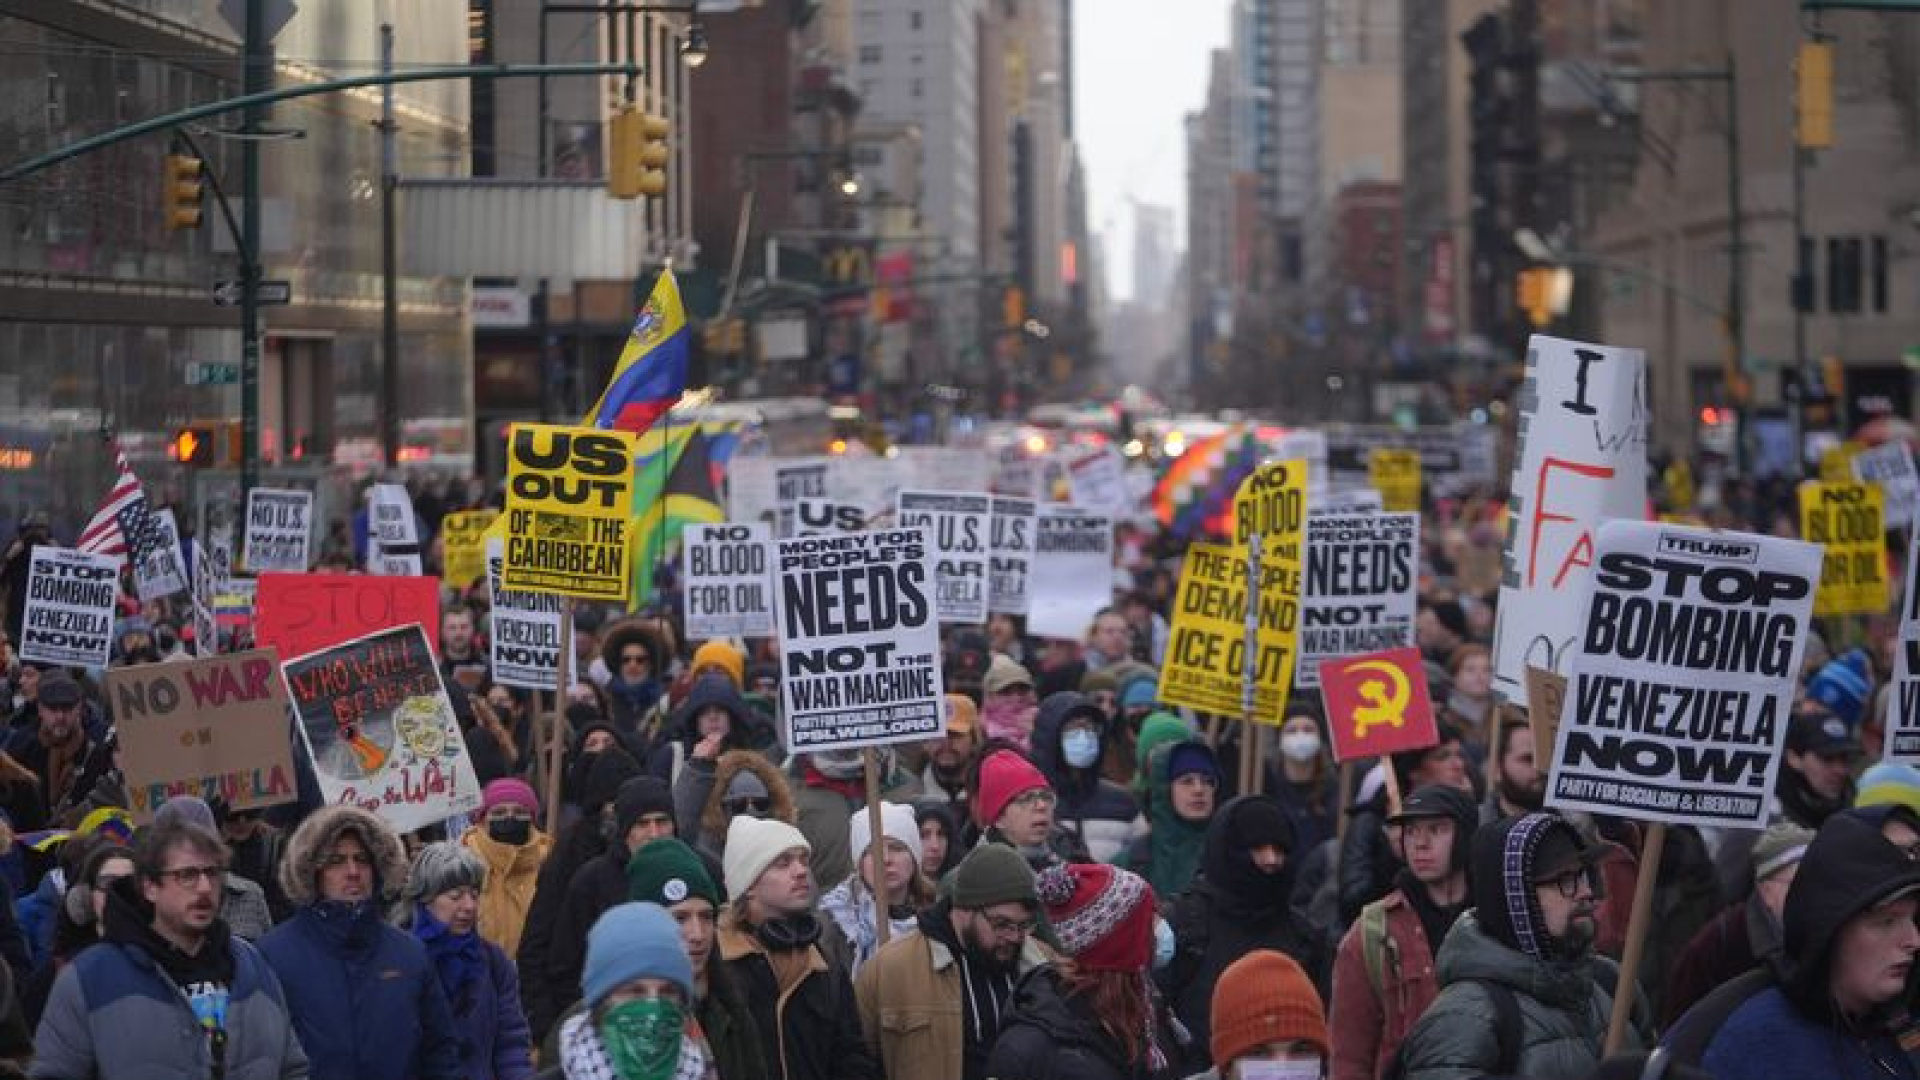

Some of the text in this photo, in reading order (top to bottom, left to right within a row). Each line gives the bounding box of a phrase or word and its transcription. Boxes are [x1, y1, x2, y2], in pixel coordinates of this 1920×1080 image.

[1561, 348, 1604, 415] I
[514, 430, 628, 476] US
[511, 472, 627, 507] OUT
[1250, 466, 1288, 494] NO
[1823, 486, 1865, 502] NO
[251, 504, 272, 527] NO
[511, 509, 625, 545] OF THE
[800, 502, 865, 531] US
[937, 514, 985, 553] U.S.
[703, 525, 751, 543] NO
[779, 530, 923, 556] MONEY FOR
[1661, 536, 1754, 559] TRUMP
[35, 559, 116, 581] STOP
[509, 538, 623, 577] CARIBBEAN
[690, 544, 765, 577] BLOOD
[781, 544, 924, 573] PEOPLE'S
[937, 560, 983, 578] AR
[1191, 550, 1230, 580] THE
[1230, 557, 1302, 597] POPLE
[1307, 542, 1412, 597] NEEDS
[30, 576, 114, 609] BOMBING
[1596, 553, 1811, 607] STOP
[278, 578, 424, 632] STOP
[690, 582, 769, 616] FOR OIL
[781, 560, 928, 640] NEEDS
[1183, 580, 1298, 633] DEMND
[1303, 604, 1386, 626] NOT
[27, 606, 109, 636] VENEZUELA
[494, 617, 561, 649] VENEZUEL
[1583, 591, 1797, 679] BOMBING
[25, 628, 107, 651] NOW!
[1172, 627, 1223, 672] ICE
[292, 637, 416, 700] WHO WILL
[786, 642, 897, 678] NOT
[117, 658, 275, 721] NO WAR
[789, 665, 938, 712] WAR MACHINE
[1575, 672, 1778, 747] VENEZUELA
[179, 727, 212, 747] ON
[1561, 730, 1773, 788] NOW!
[131, 764, 292, 812] VENEZUELA
[1558, 777, 1758, 815] PARTY FOR SOCIALISM & LIBERATION
